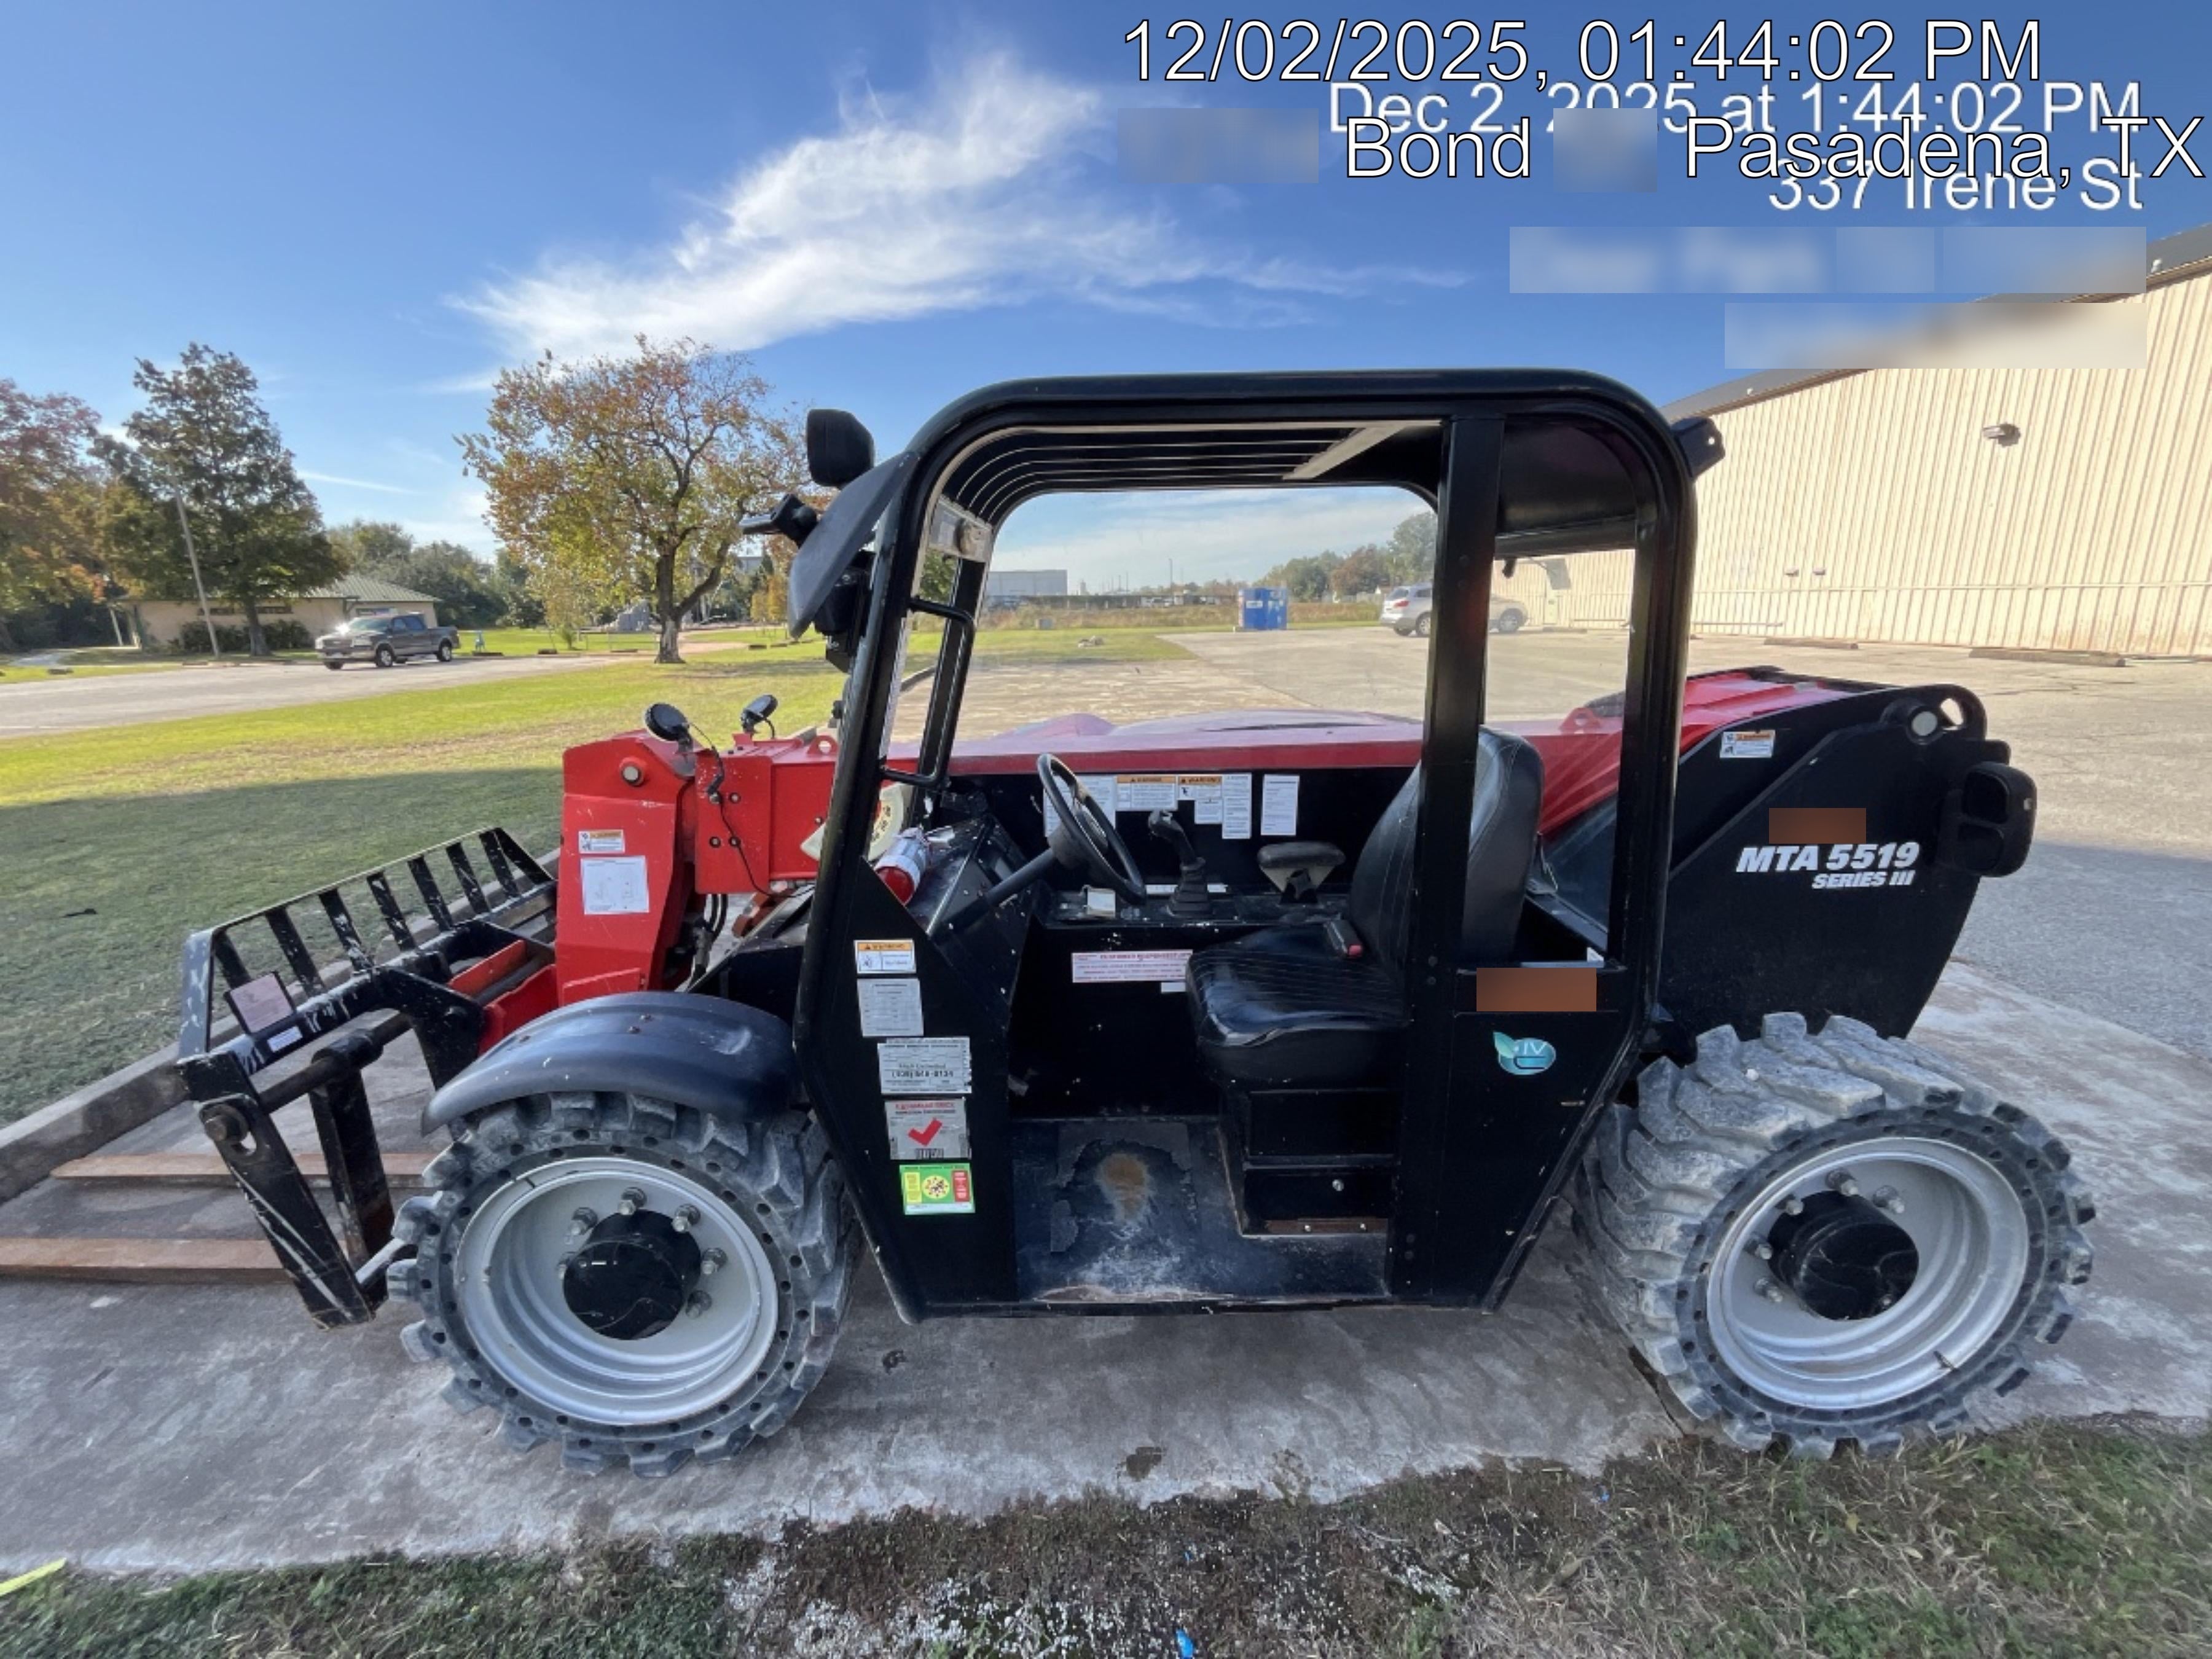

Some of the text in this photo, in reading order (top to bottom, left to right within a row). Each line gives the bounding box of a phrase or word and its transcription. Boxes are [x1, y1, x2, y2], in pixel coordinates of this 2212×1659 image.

[1735, 841, 1920, 873] MTA 5519
[1811, 869, 1916, 889] SERIES III
